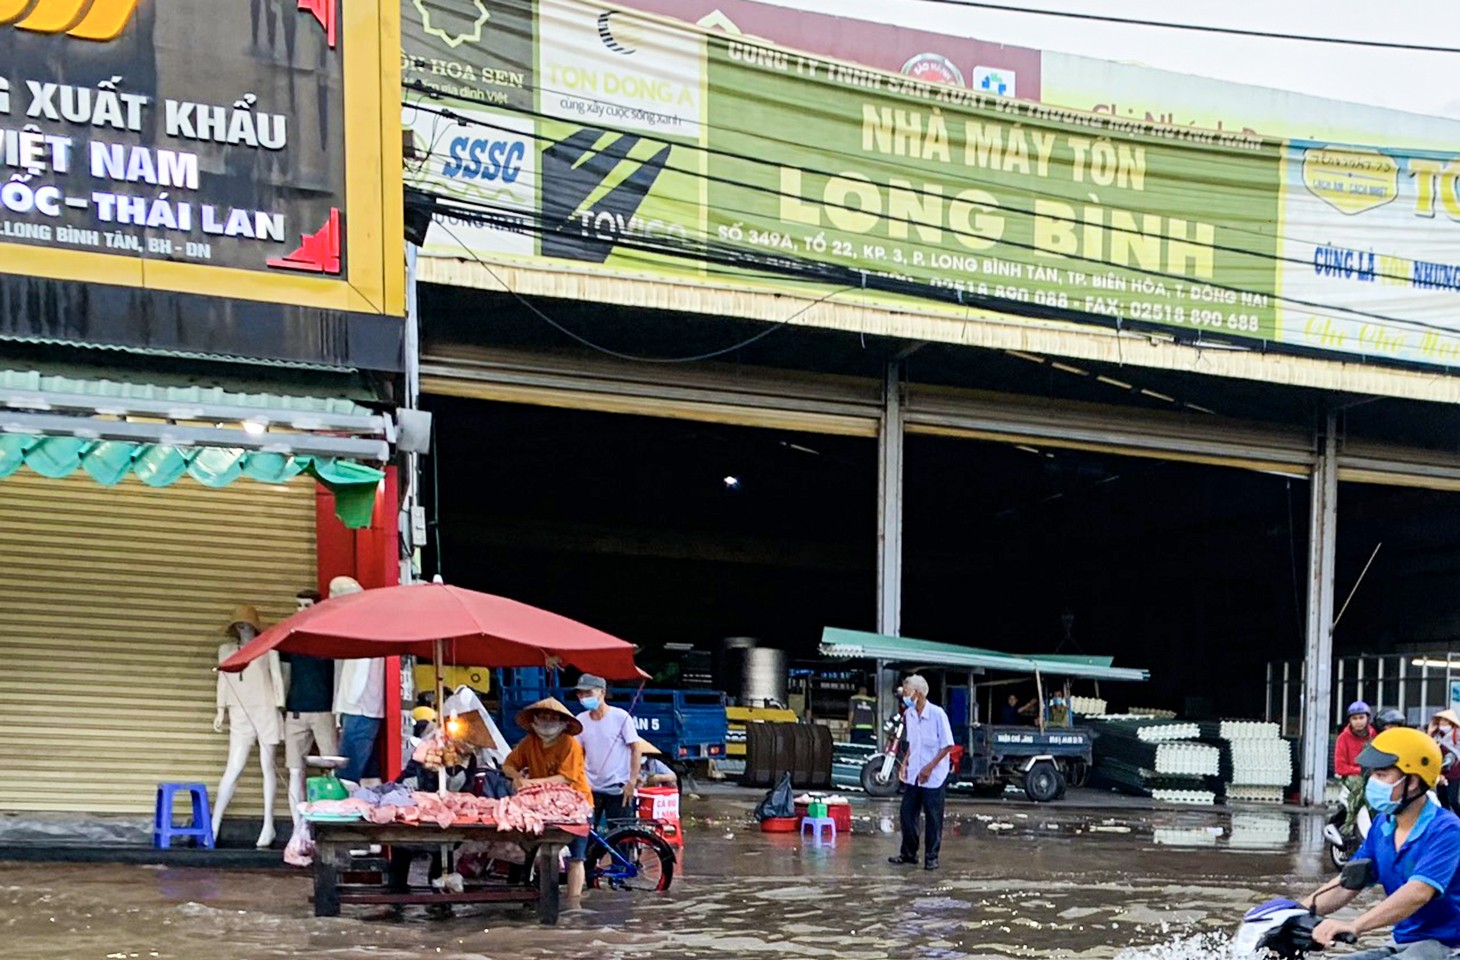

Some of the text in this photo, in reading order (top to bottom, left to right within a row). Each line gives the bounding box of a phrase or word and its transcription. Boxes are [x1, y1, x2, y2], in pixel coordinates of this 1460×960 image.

[431, 59, 525, 88] HOA SEN
[26, 76, 149, 132] XUẤT
[165, 93, 287, 149] KHẨU
[560, 96, 585, 114] cùng
[0, 124, 199, 190] IỆT NAM
[442, 136, 525, 183] SSSC
[862, 102, 1147, 192] NHÀ MÁY TÔN
[56, 224, 99, 246] BÌNH
[104, 229, 143, 252] TÂN,
[148, 237, 173, 255] BH
[201, 205, 285, 242] LAN
[780, 167, 1215, 279] LONG BÌNH
[718, 221, 744, 242] SỐ
[749, 229, 798, 252] 349A,
[832, 240, 858, 260] 22,
[863, 244, 887, 260] KP.
[893, 247, 908, 266] 3,
[913, 251, 925, 267] P.
[931, 254, 978, 273] LONG
[983, 256, 1022, 279] BÌNH
[1026, 262, 1063, 286] TÂN,
[1067, 271, 1088, 286] TP.
[1092, 271, 1127, 290] BIÊN
[1085, 295, 1125, 317] FAX:
[1130, 301, 1186, 324] 02518
[1190, 309, 1223, 328] 890
[1227, 314, 1260, 333] 688
[651, 718, 660, 731] 5
